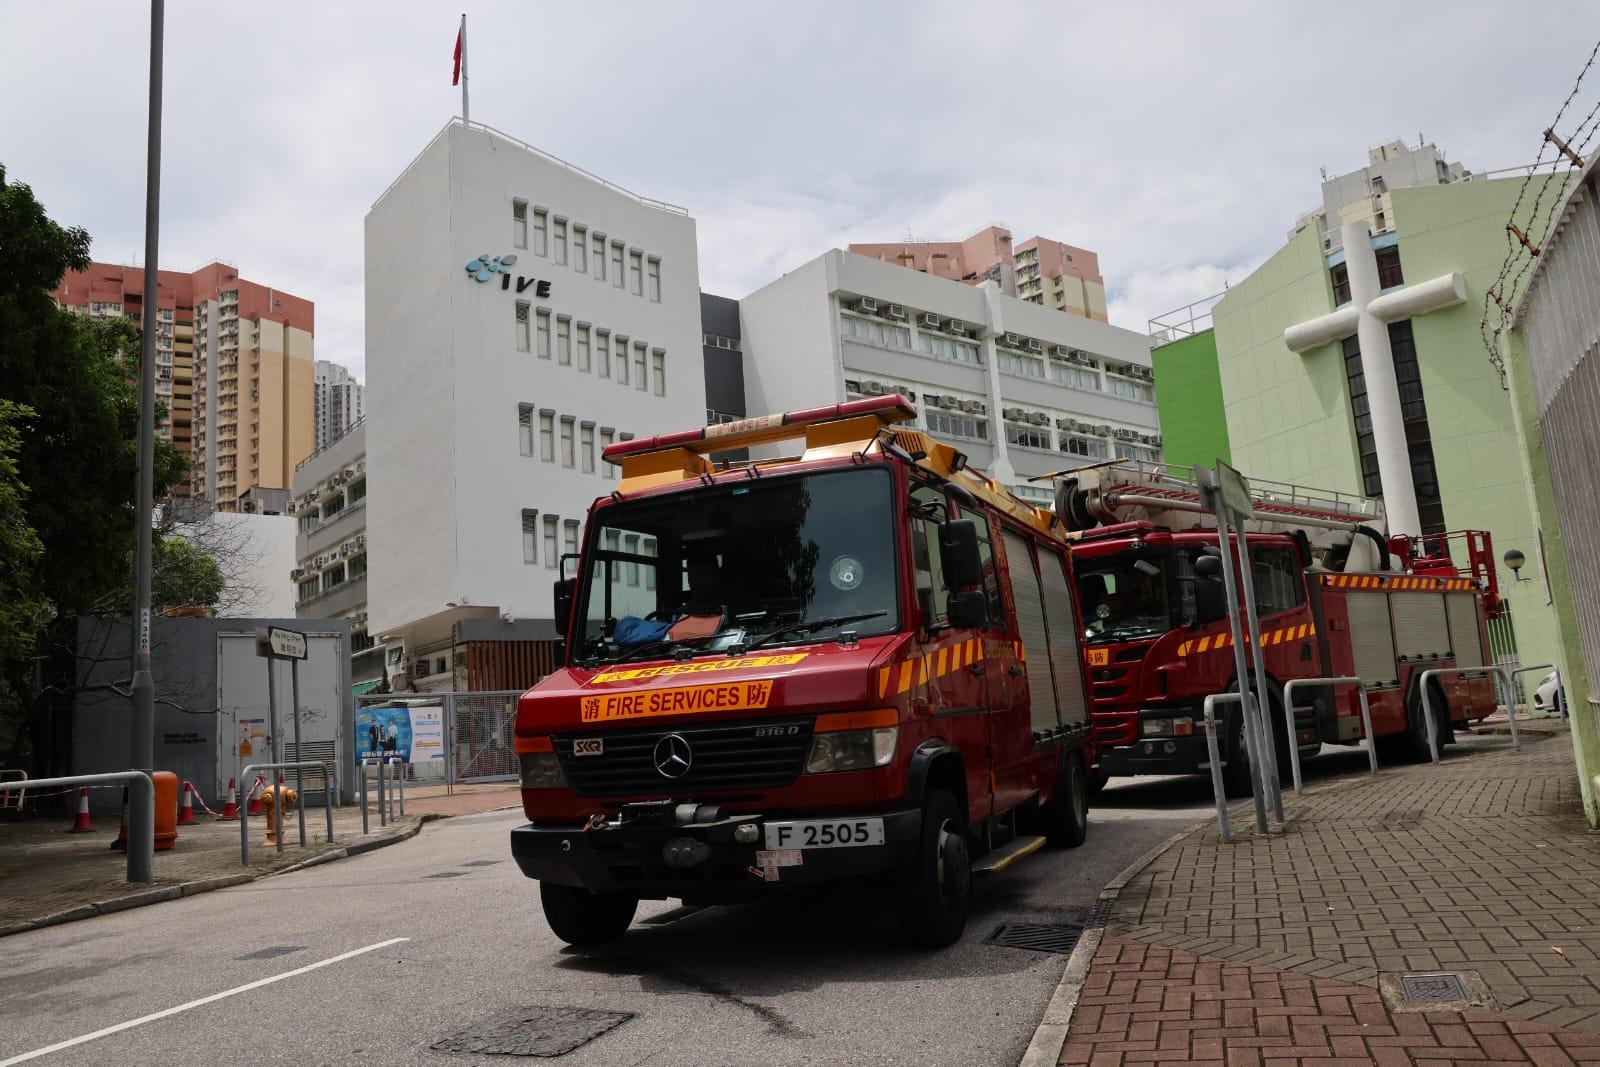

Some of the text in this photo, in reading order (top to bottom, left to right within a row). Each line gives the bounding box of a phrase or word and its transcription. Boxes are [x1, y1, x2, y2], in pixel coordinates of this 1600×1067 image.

[502, 273, 551, 298] IVE
[635, 658, 755, 677] RESCUE
[585, 683, 767, 719] 消 FIRE SERVICES 防
[778, 822, 869, 847] F 2505
